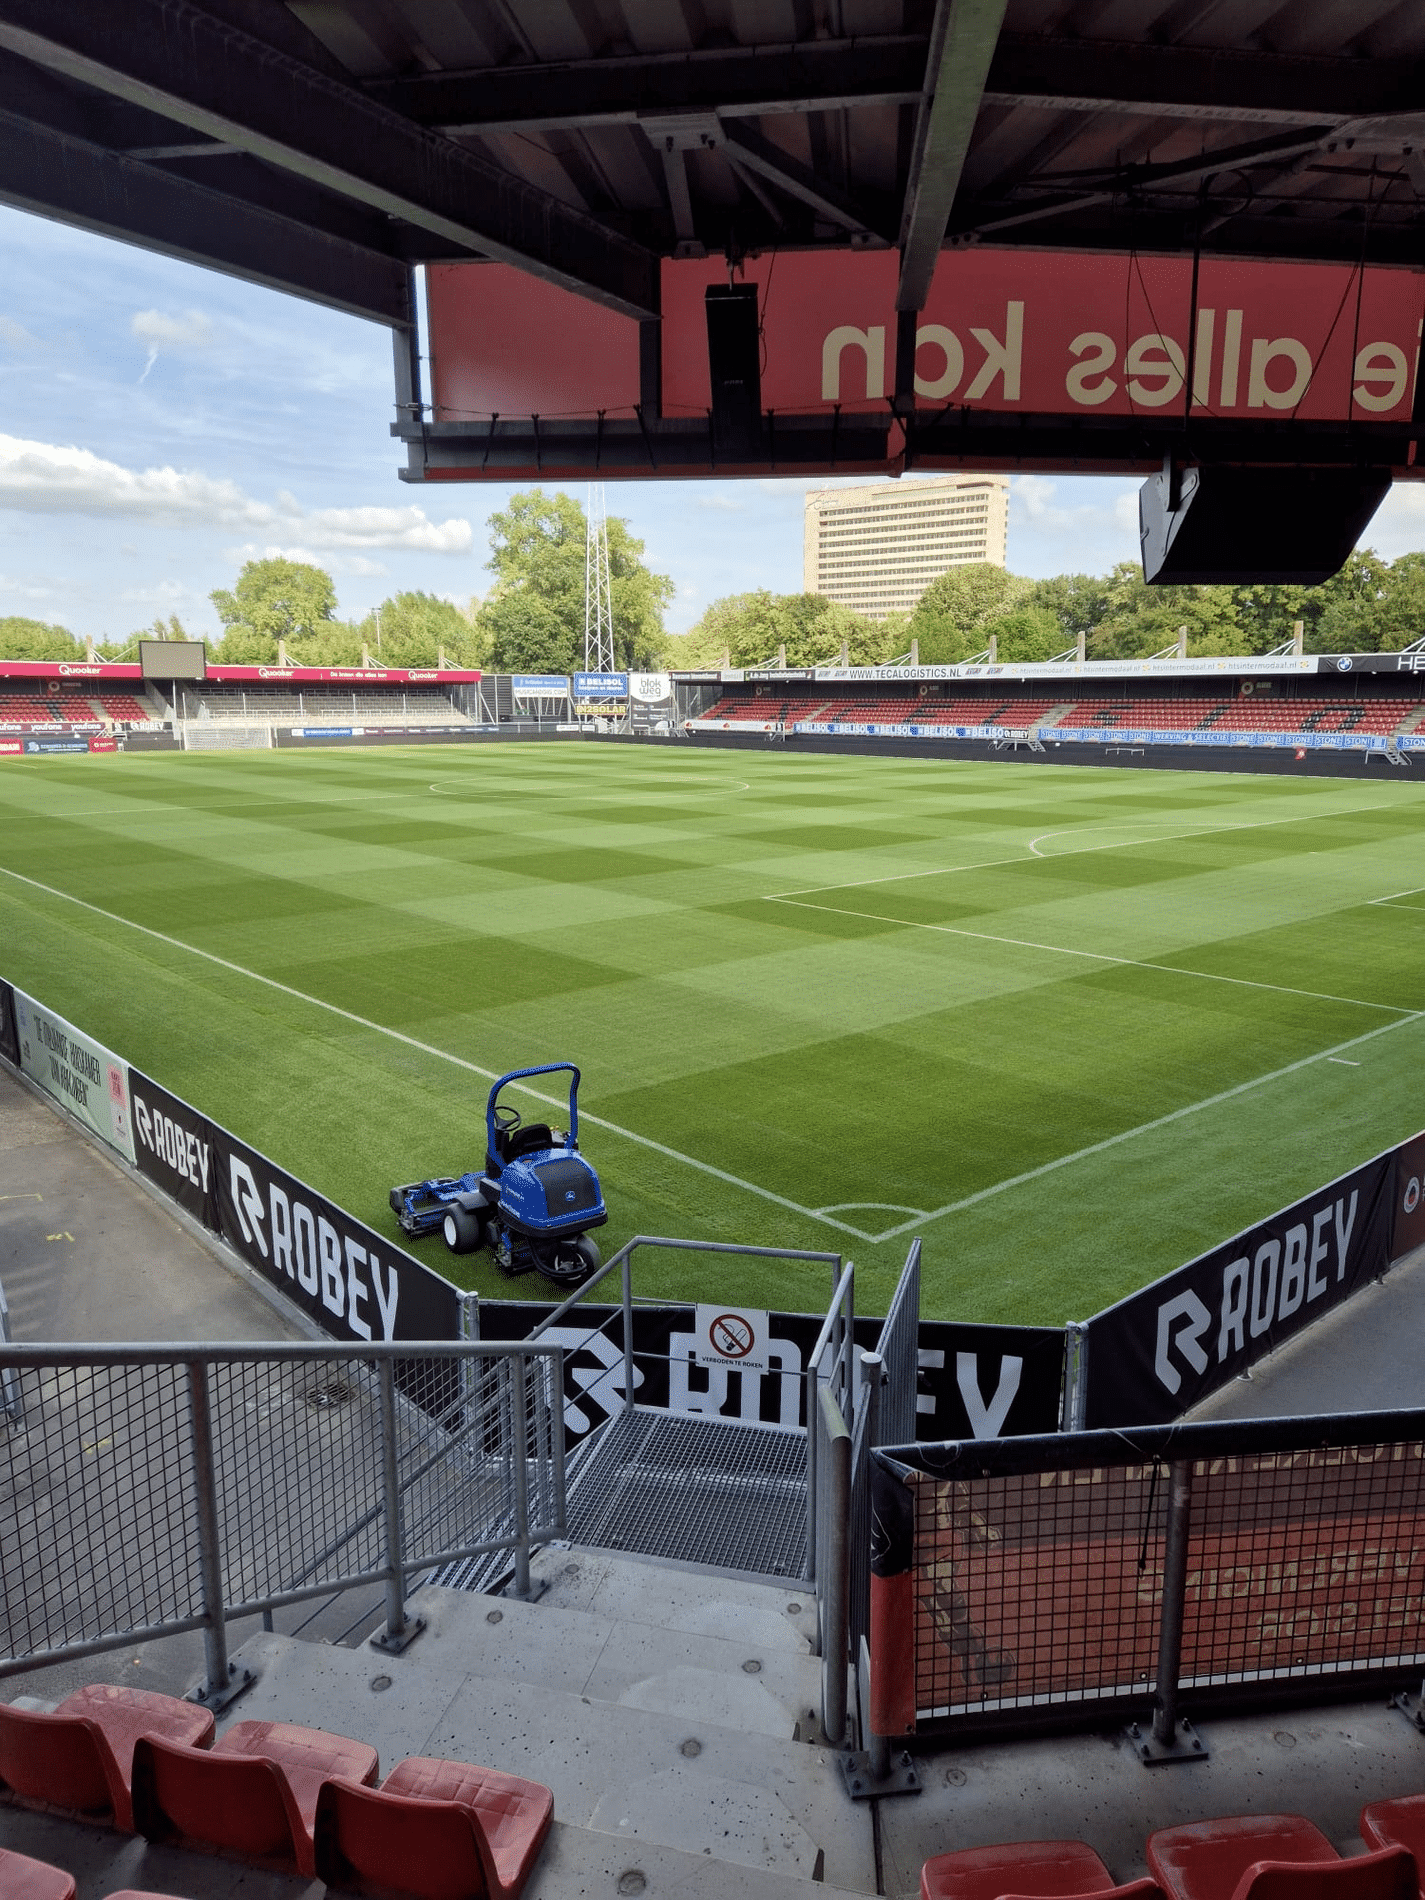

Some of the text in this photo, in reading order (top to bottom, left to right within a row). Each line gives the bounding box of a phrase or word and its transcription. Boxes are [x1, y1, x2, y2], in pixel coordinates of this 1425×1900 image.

[58, 664, 102, 676] Quooker
[1228, 661, 1297, 670] htsintermodaal.nl
[258, 668, 295, 679] Quooker
[408, 670, 439, 680] Quooker
[849, 668, 962, 679] WWW.TECALOGISTICS.NL
[640, 677, 661, 688] blok
[639, 687, 661, 697] weg
[576, 705, 626, 713] IN2SOLAR
[31, 723, 62, 732] youfone
[71, 722, 101, 731] youfone
[1289, 735, 1311, 743] STONE
[1317, 736, 1340, 744] STONE
[153, 1107, 210, 1193] ROBEY
[269, 1182, 399, 1342] ROBEY
[1218, 1189, 1359, 1364] ROBEY
[702, 1356, 734, 1365] VERBODEN
[742, 1361, 763, 1369] ROKEN
